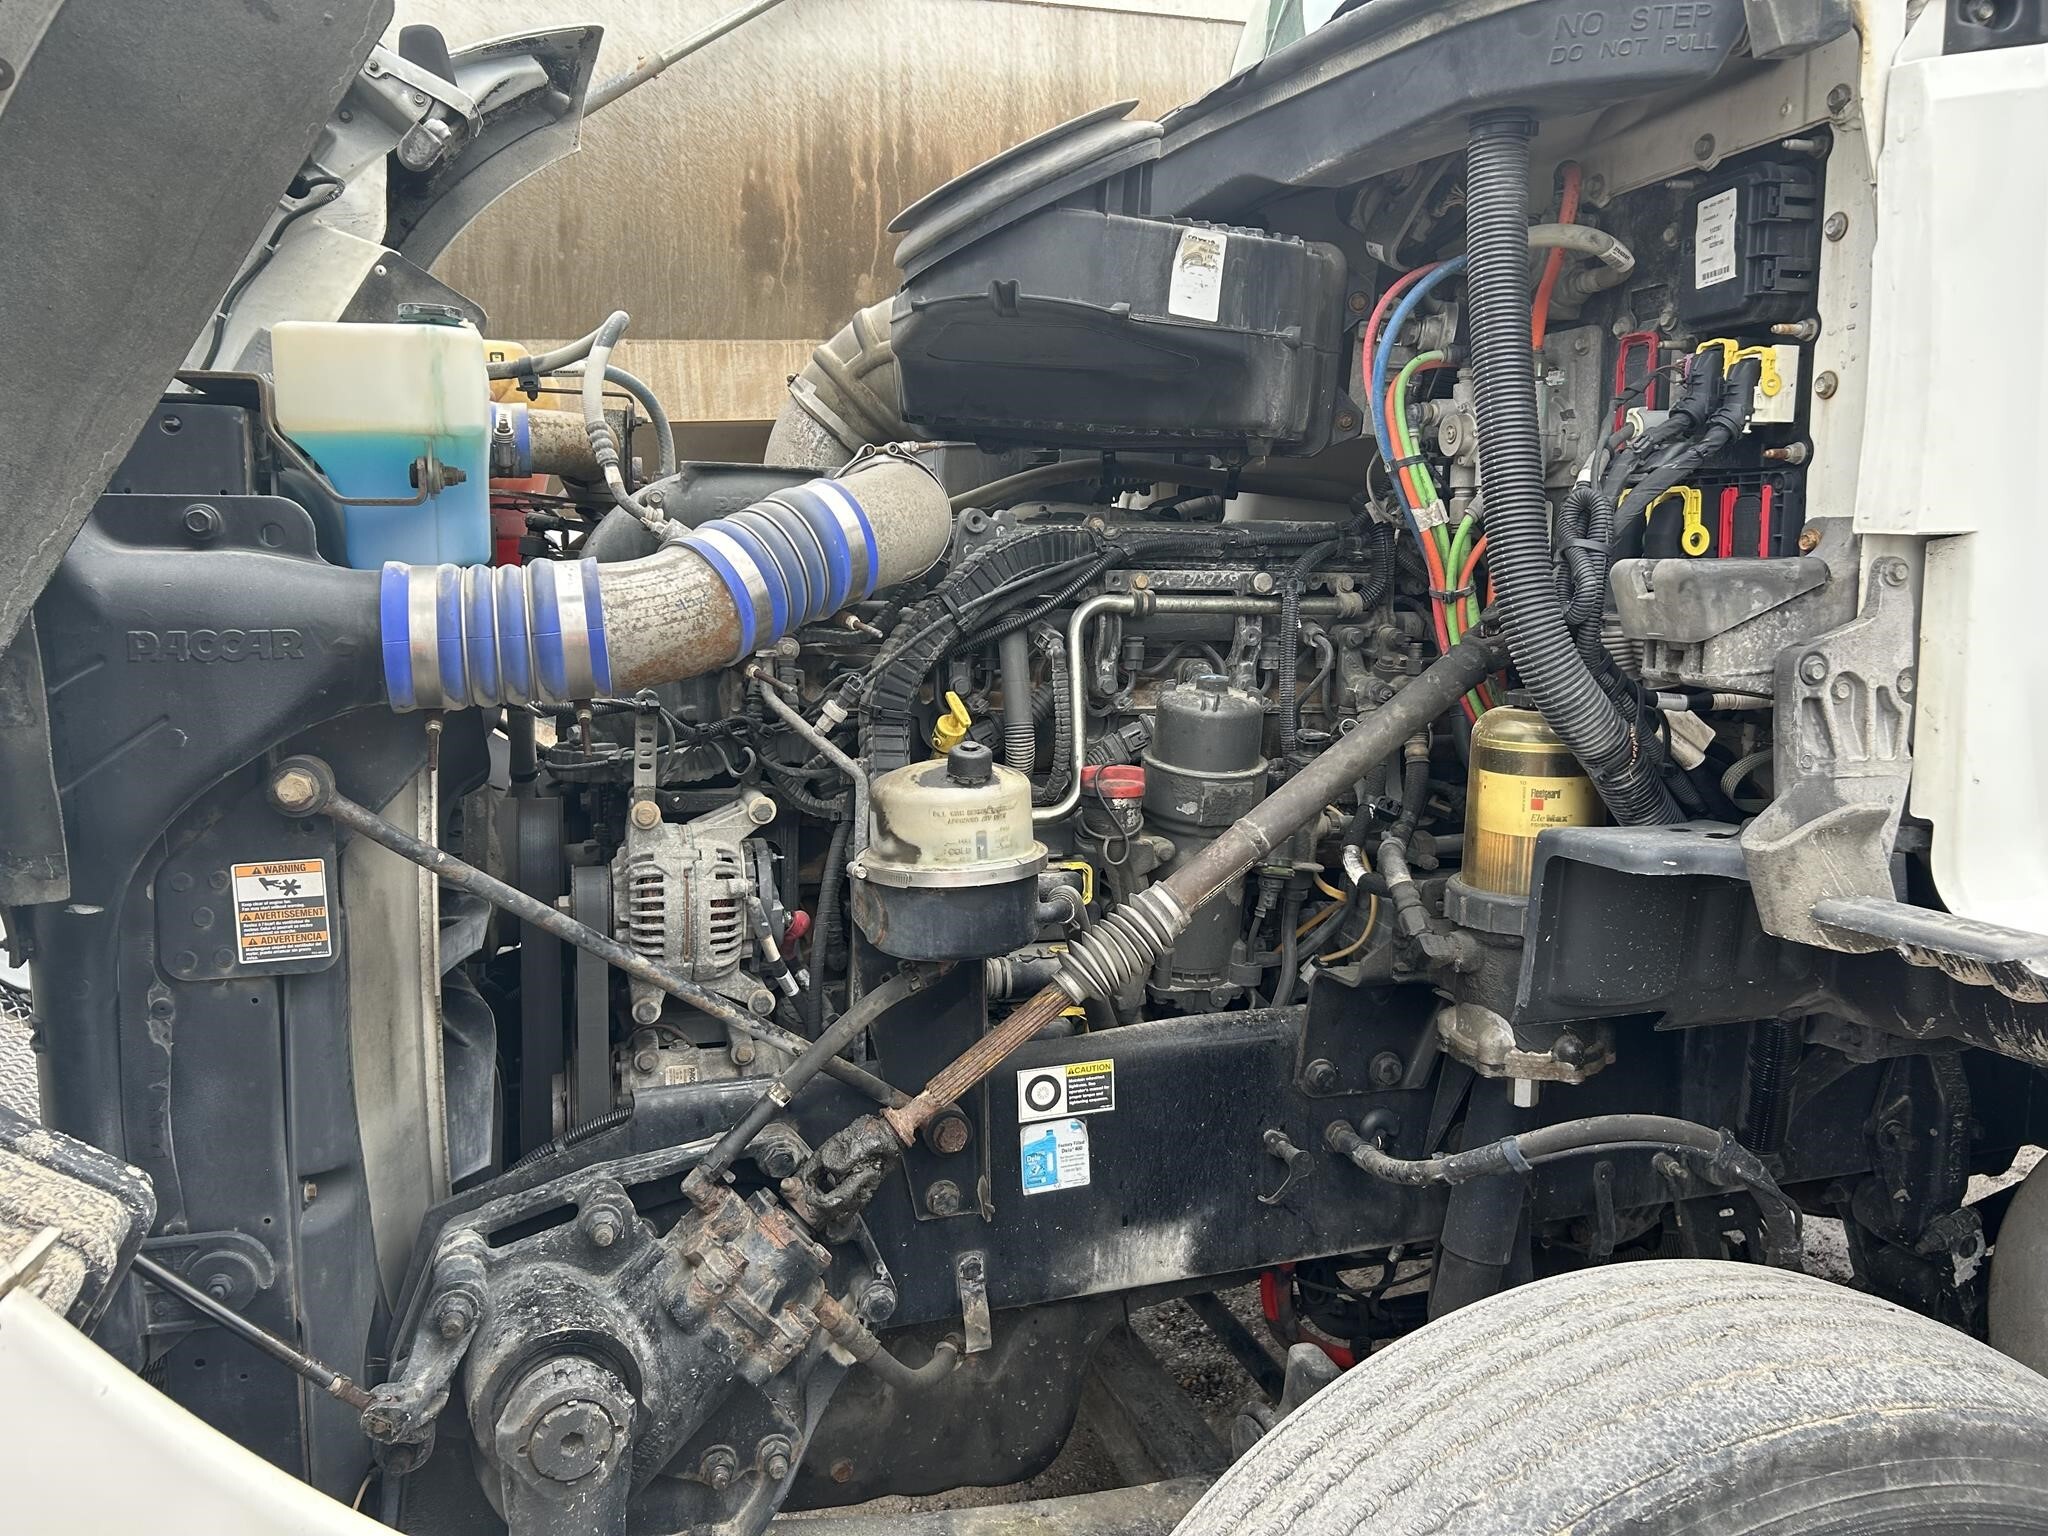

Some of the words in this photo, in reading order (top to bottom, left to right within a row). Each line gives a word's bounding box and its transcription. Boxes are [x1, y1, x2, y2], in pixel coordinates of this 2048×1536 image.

[1555, 10, 1604, 40] NO
[1630, 3, 1713, 32] STEP
[1549, 44, 1584, 65] DO
[1600, 38, 1649, 59] NOT
[1663, 33, 1719, 54] PULL
[127, 629, 304, 662] PACCAR
[1530, 788, 1561, 800] Fleetguard
[263, 864, 306, 874] WARNING
[254, 908, 324, 920] AVERTISSEMENT
[261, 933, 322, 944] ADVERTENCIA
[1075, 1063, 1110, 1074] CAUTION
